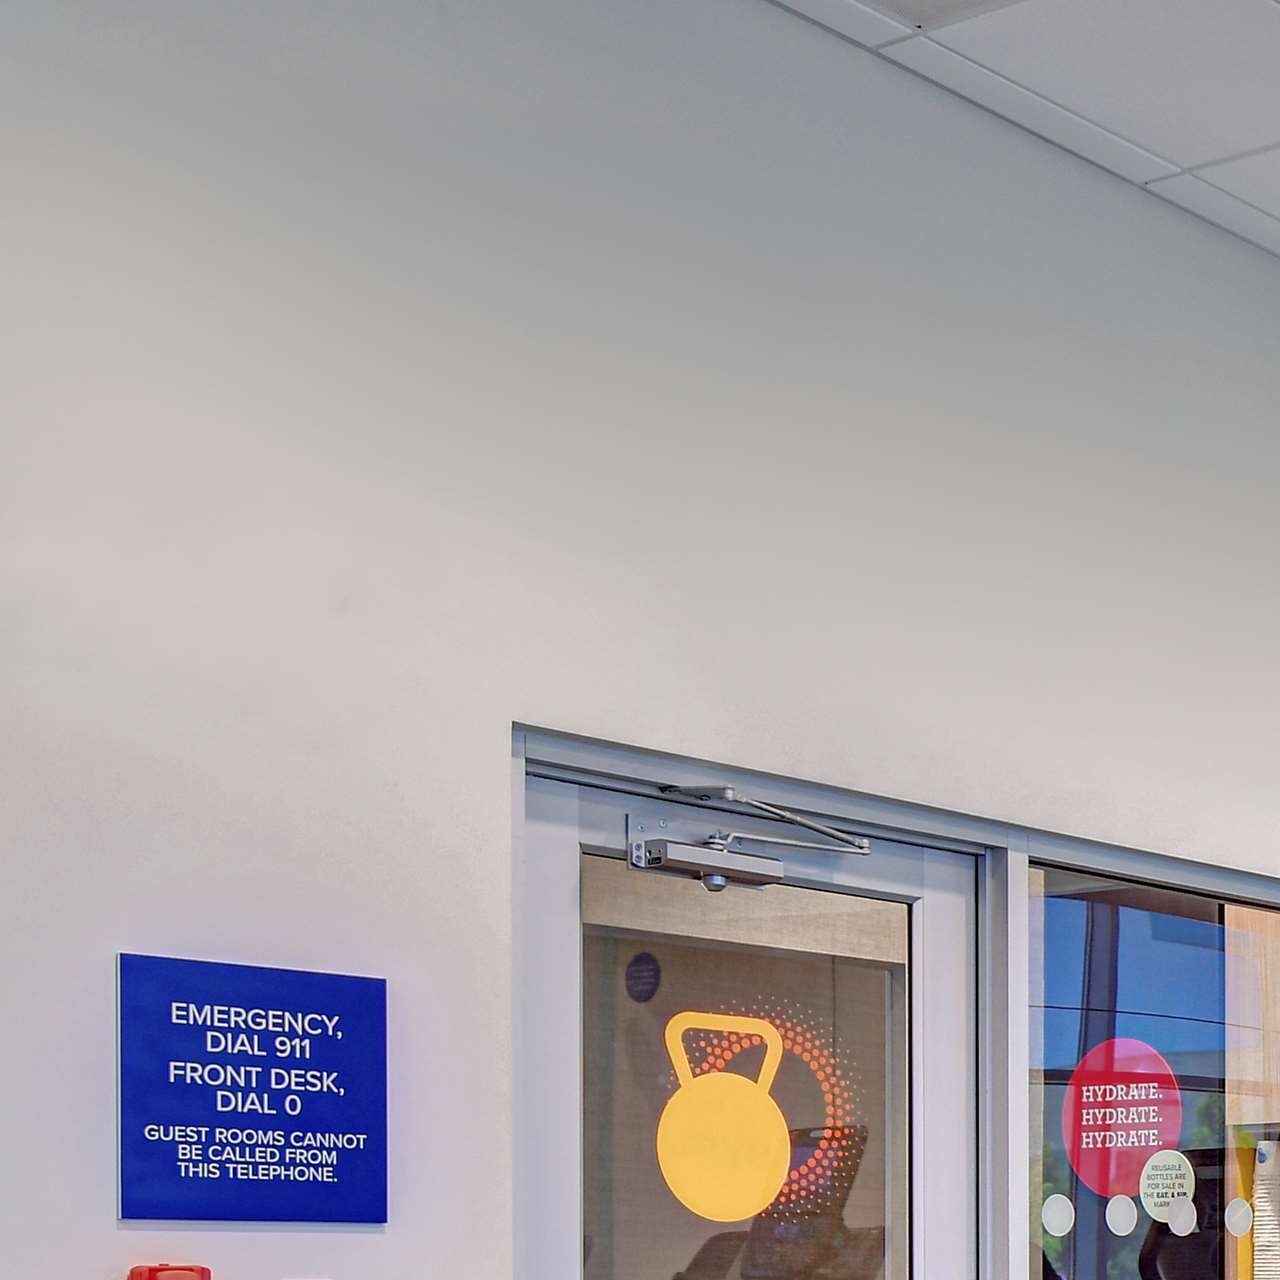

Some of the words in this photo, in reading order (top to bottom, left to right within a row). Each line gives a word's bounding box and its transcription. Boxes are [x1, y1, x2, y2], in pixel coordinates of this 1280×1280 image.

[171, 1001, 343, 1040] EMERGENCY,
[206, 1031, 267, 1056] DIAL
[275, 1037, 311, 1059] 911
[169, 1061, 261, 1088] FRONT
[270, 1069, 345, 1096] DESK,
[216, 1091, 277, 1115] DIAL
[285, 1095, 301, 1116] 0
[1081, 1083, 1163, 1102] HYDRATE.
[1081, 1106, 1163, 1125] HYDRATE.
[144, 1125, 209, 1143] GUEST
[215, 1128, 285, 1146] ROOMS
[290, 1131, 367, 1150] CANNOT
[1081, 1130, 1163, 1148] HYDRATE.
[178, 1145, 202, 1160] BE
[208, 1146, 280, 1163] CALLED
[285, 1149, 337, 1165] FROM
[177, 1162, 220, 1178] THIS
[225, 1163, 337, 1182] TELEPHONE.
